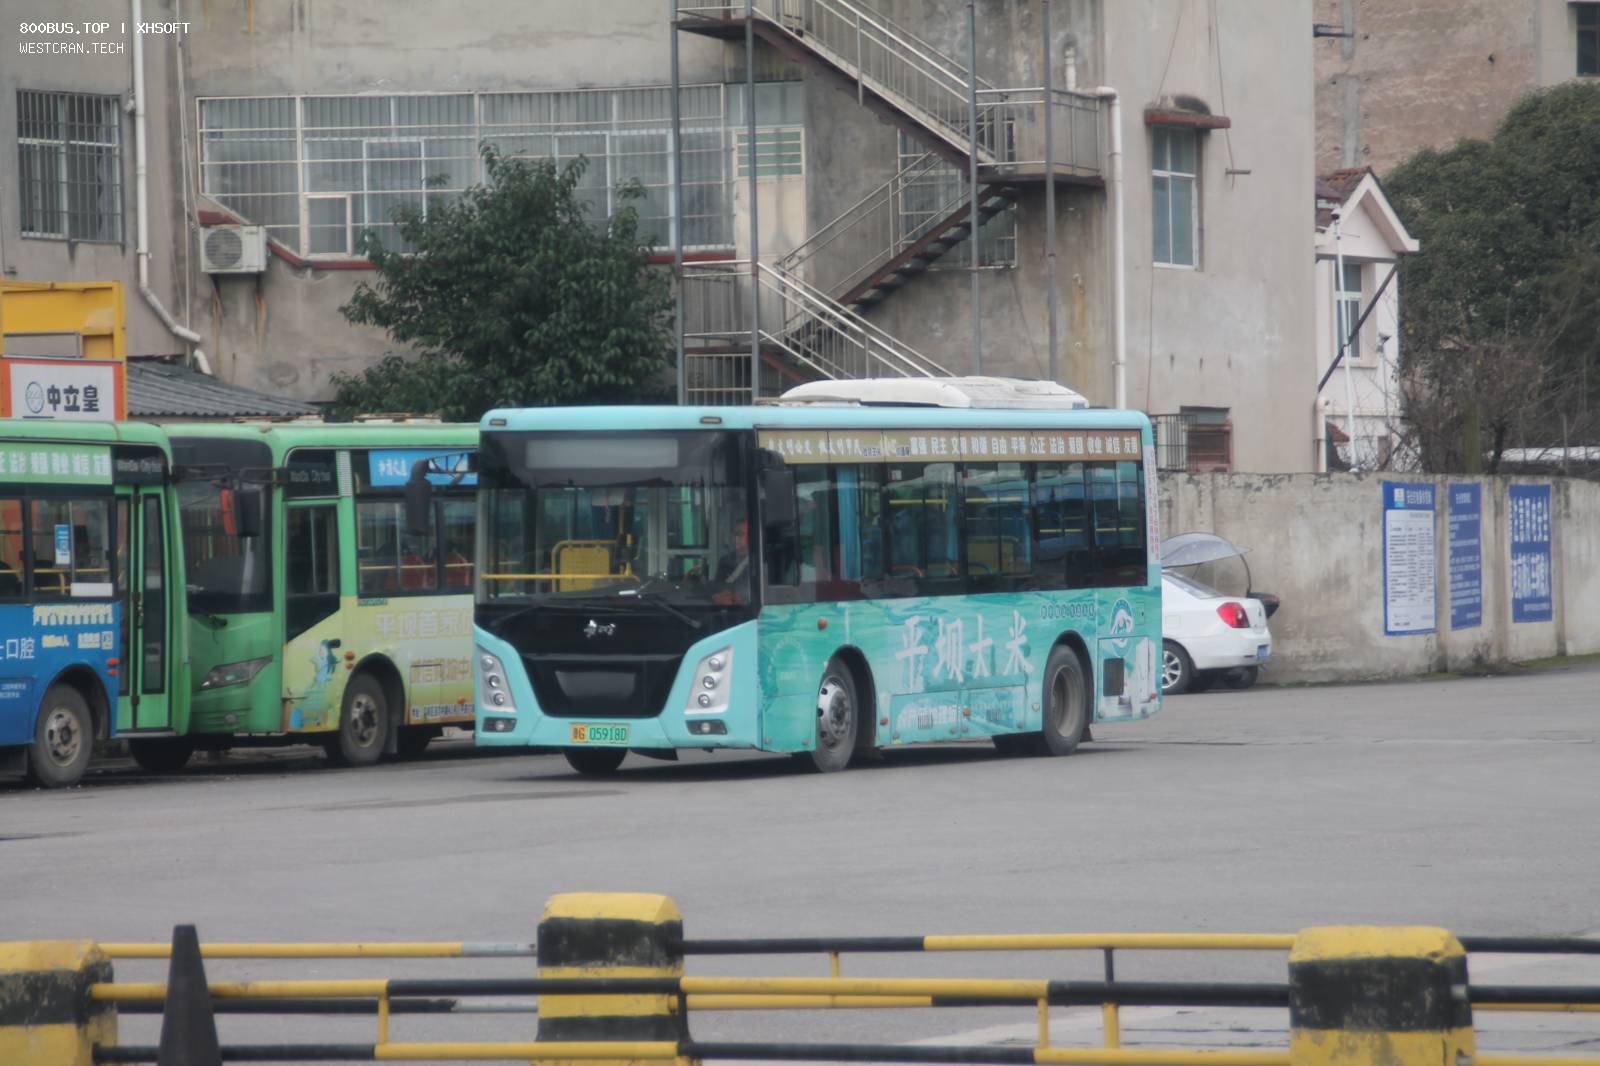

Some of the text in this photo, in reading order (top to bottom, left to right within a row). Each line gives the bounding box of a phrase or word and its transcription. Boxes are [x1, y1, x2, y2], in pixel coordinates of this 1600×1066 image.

[47, 384, 100, 412] 中立皇
[0, 638, 35, 659] 口腔
[896, 610, 1035, 691] 平坝大米
